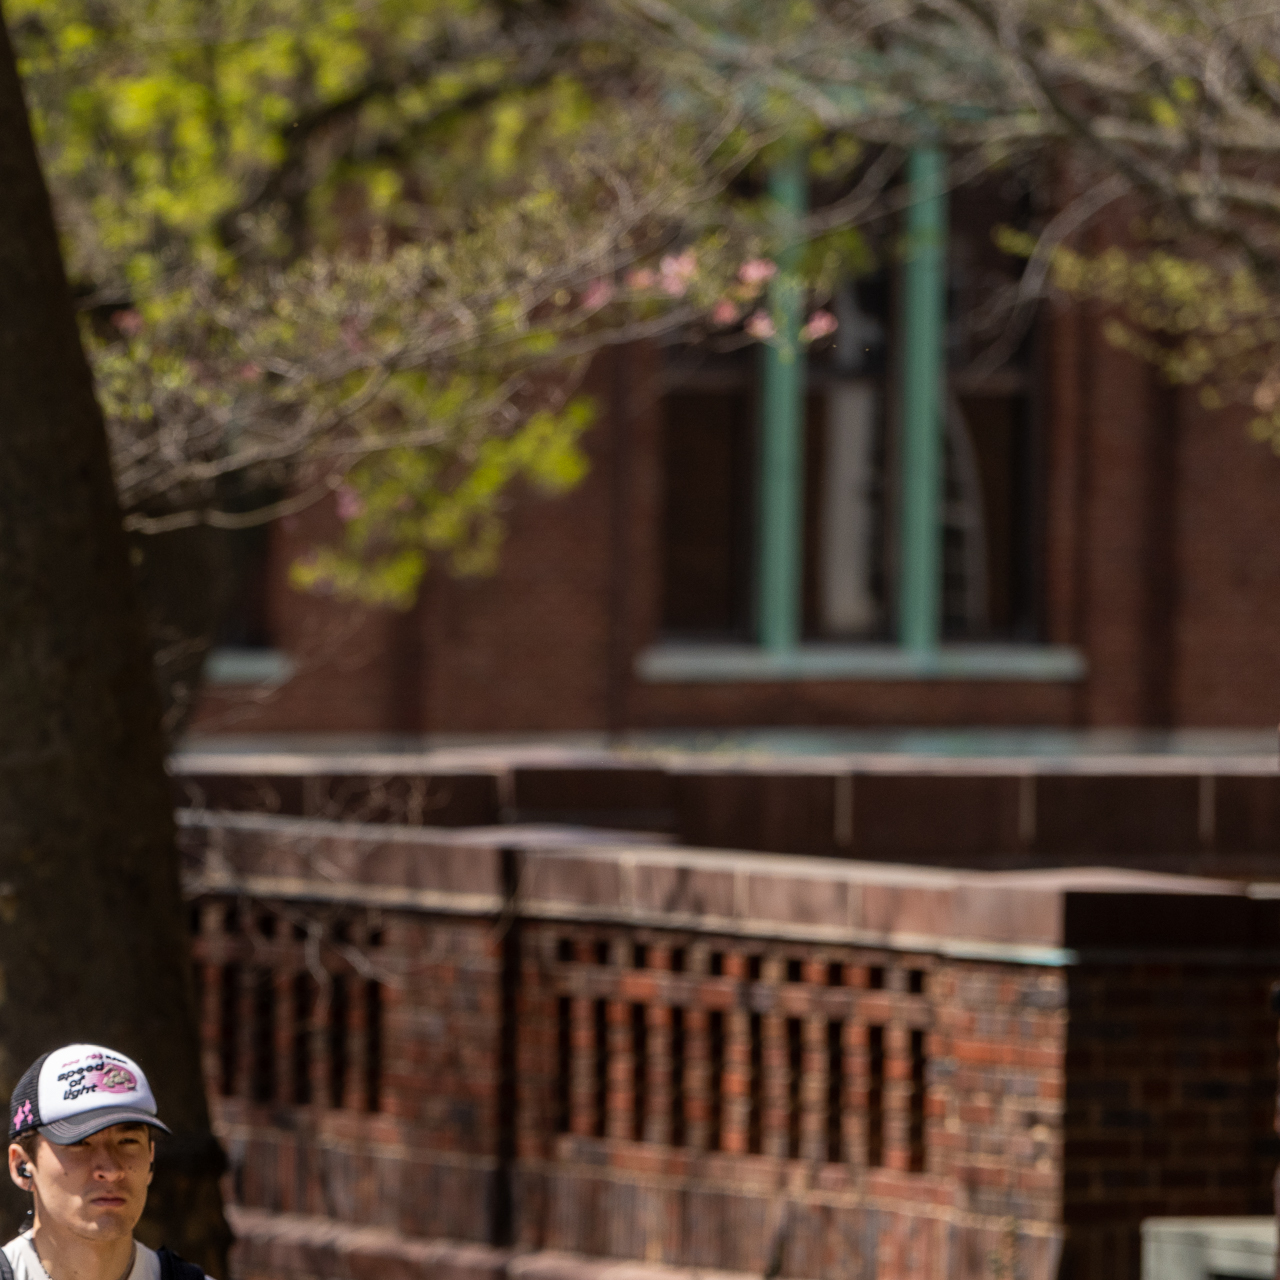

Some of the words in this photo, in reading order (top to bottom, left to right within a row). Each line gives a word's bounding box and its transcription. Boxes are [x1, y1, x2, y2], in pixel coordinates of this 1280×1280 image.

[58, 1061, 105, 1081] speed
[69, 1074, 86, 1087] of
[63, 1083, 99, 1100] light
